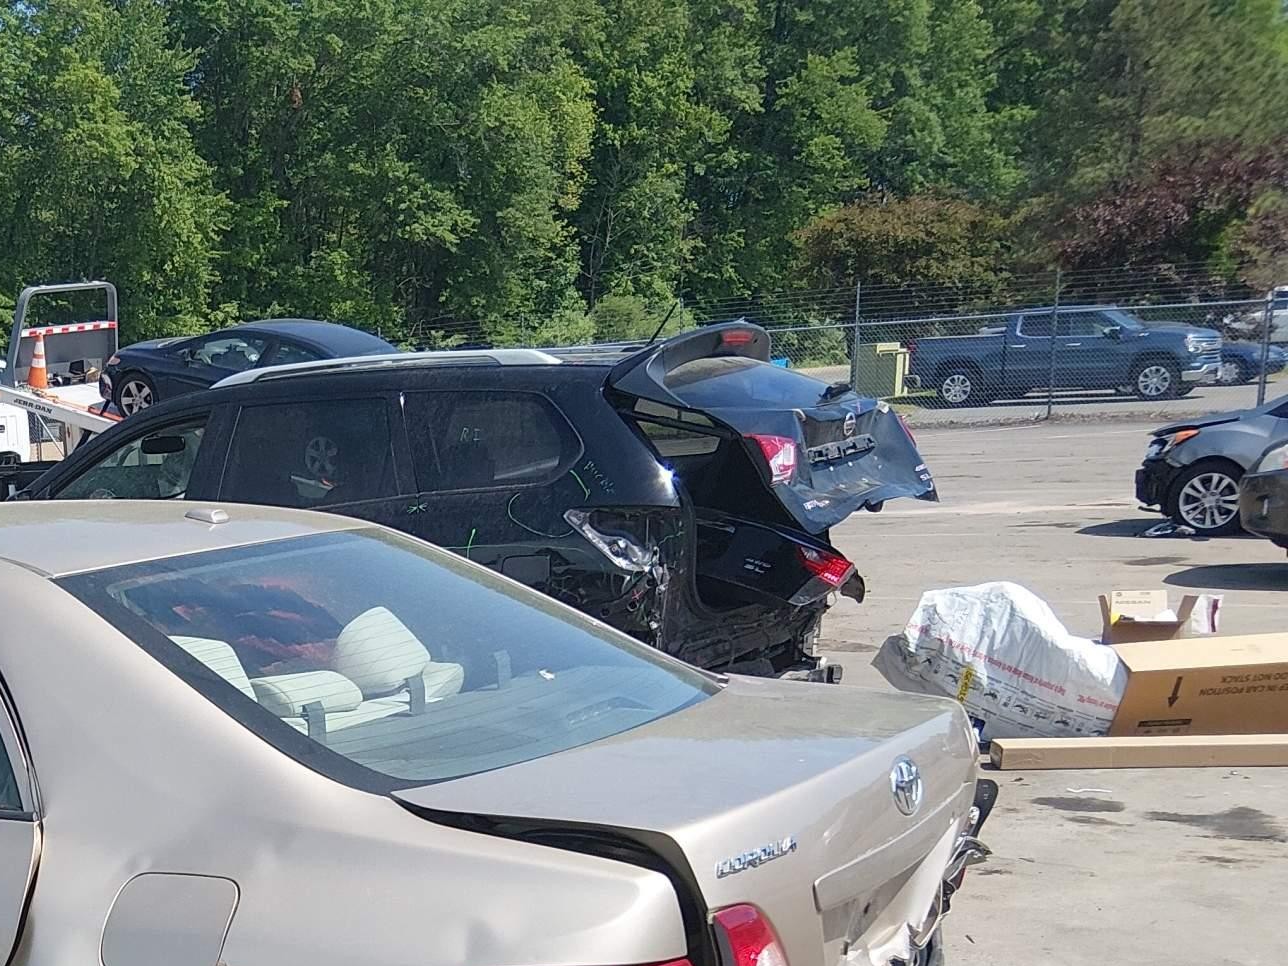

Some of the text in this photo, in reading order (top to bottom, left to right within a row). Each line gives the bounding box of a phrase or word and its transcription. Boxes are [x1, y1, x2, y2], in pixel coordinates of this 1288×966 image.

[1221, 674, 1251, 683] STACK
[1199, 686, 1244, 697] POSITION
[717, 836, 797, 878] COROLLA
